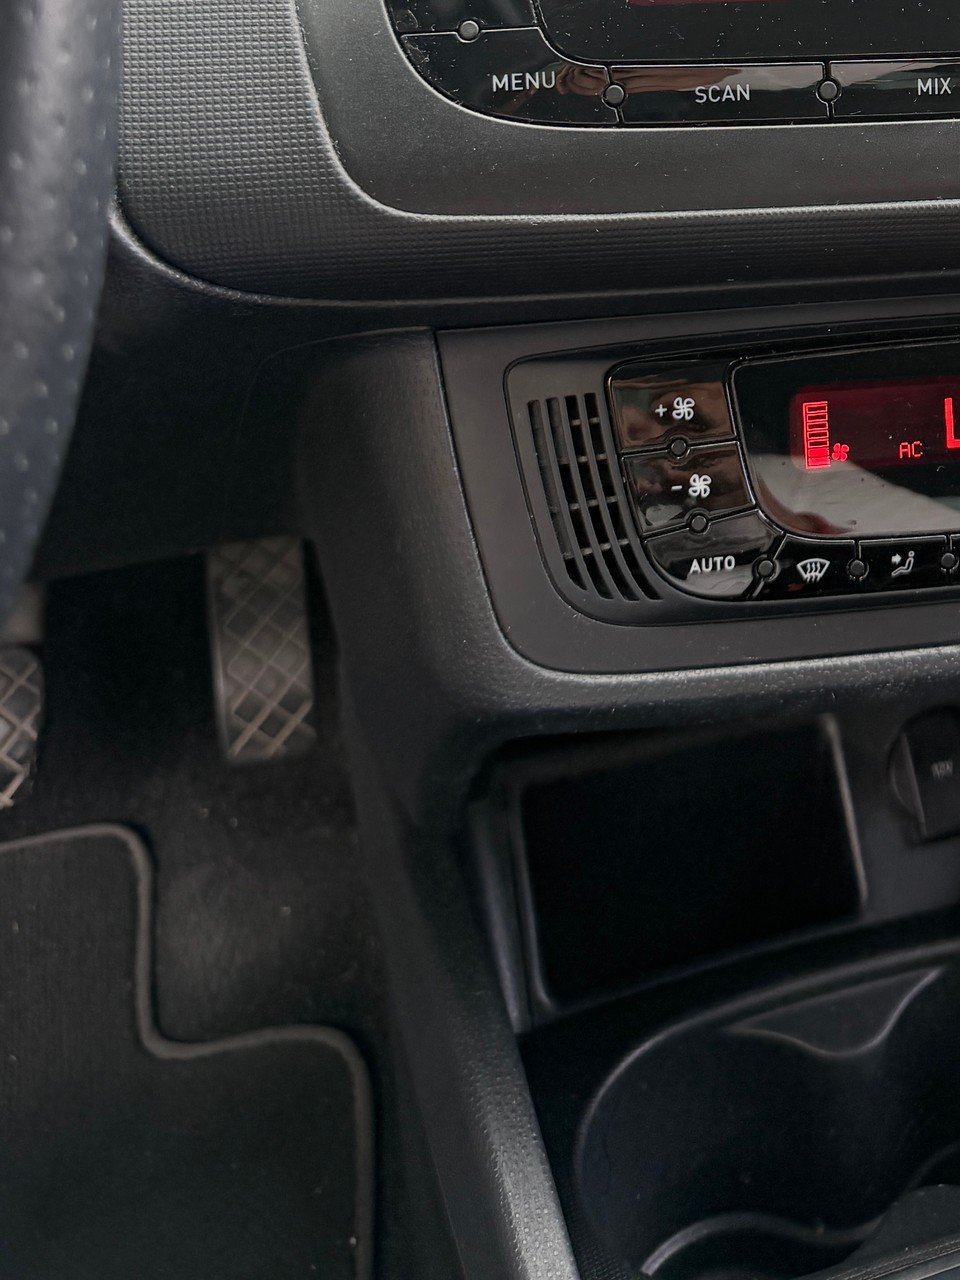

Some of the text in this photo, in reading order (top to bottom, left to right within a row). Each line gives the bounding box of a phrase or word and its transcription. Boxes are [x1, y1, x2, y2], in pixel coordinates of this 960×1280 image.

[491, 71, 556, 92] MENU
[917, 78, 952, 96] MIX
[694, 84, 751, 104] SCAN
[899, 440, 924, 459] AC
[689, 555, 736, 574] AUTO
